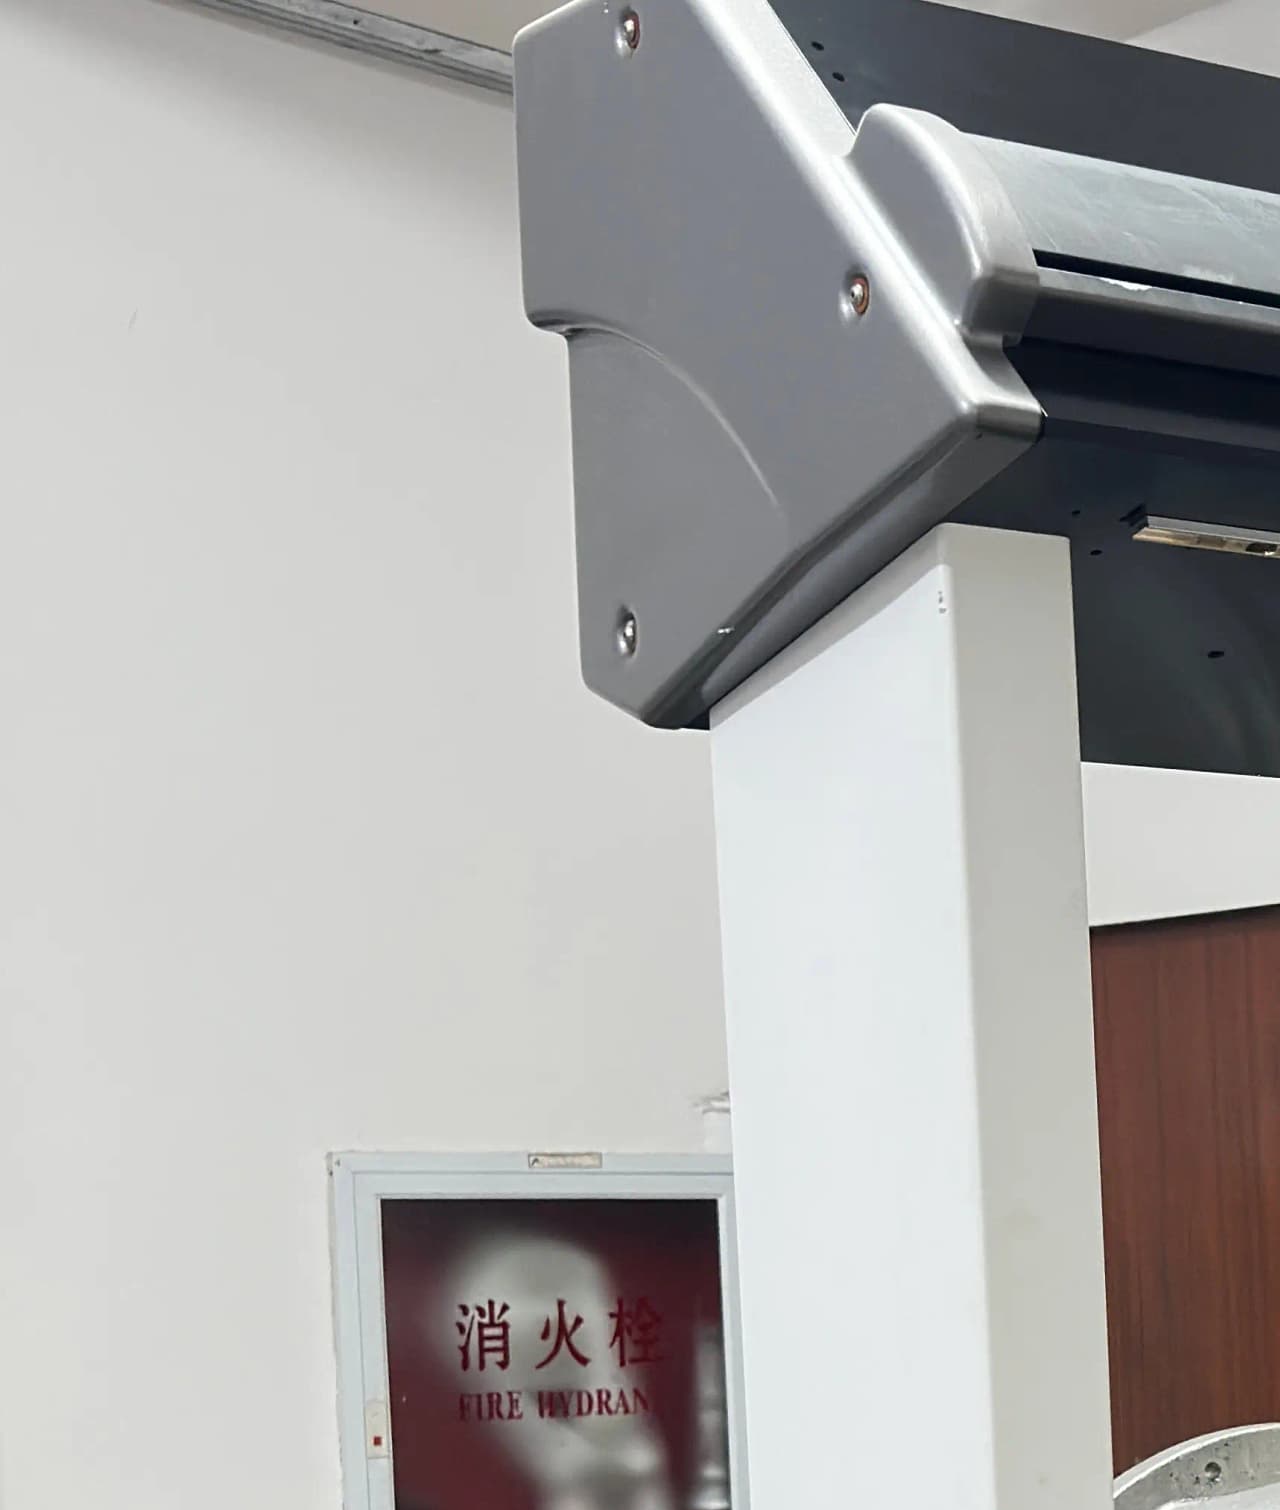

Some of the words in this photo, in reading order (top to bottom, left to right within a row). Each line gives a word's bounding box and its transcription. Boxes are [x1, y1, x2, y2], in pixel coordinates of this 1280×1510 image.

[454, 1296, 665, 1372] 消火栓
[458, 1391, 523, 1422] FIRE
[537, 1387, 650, 1419] HYDRAN
